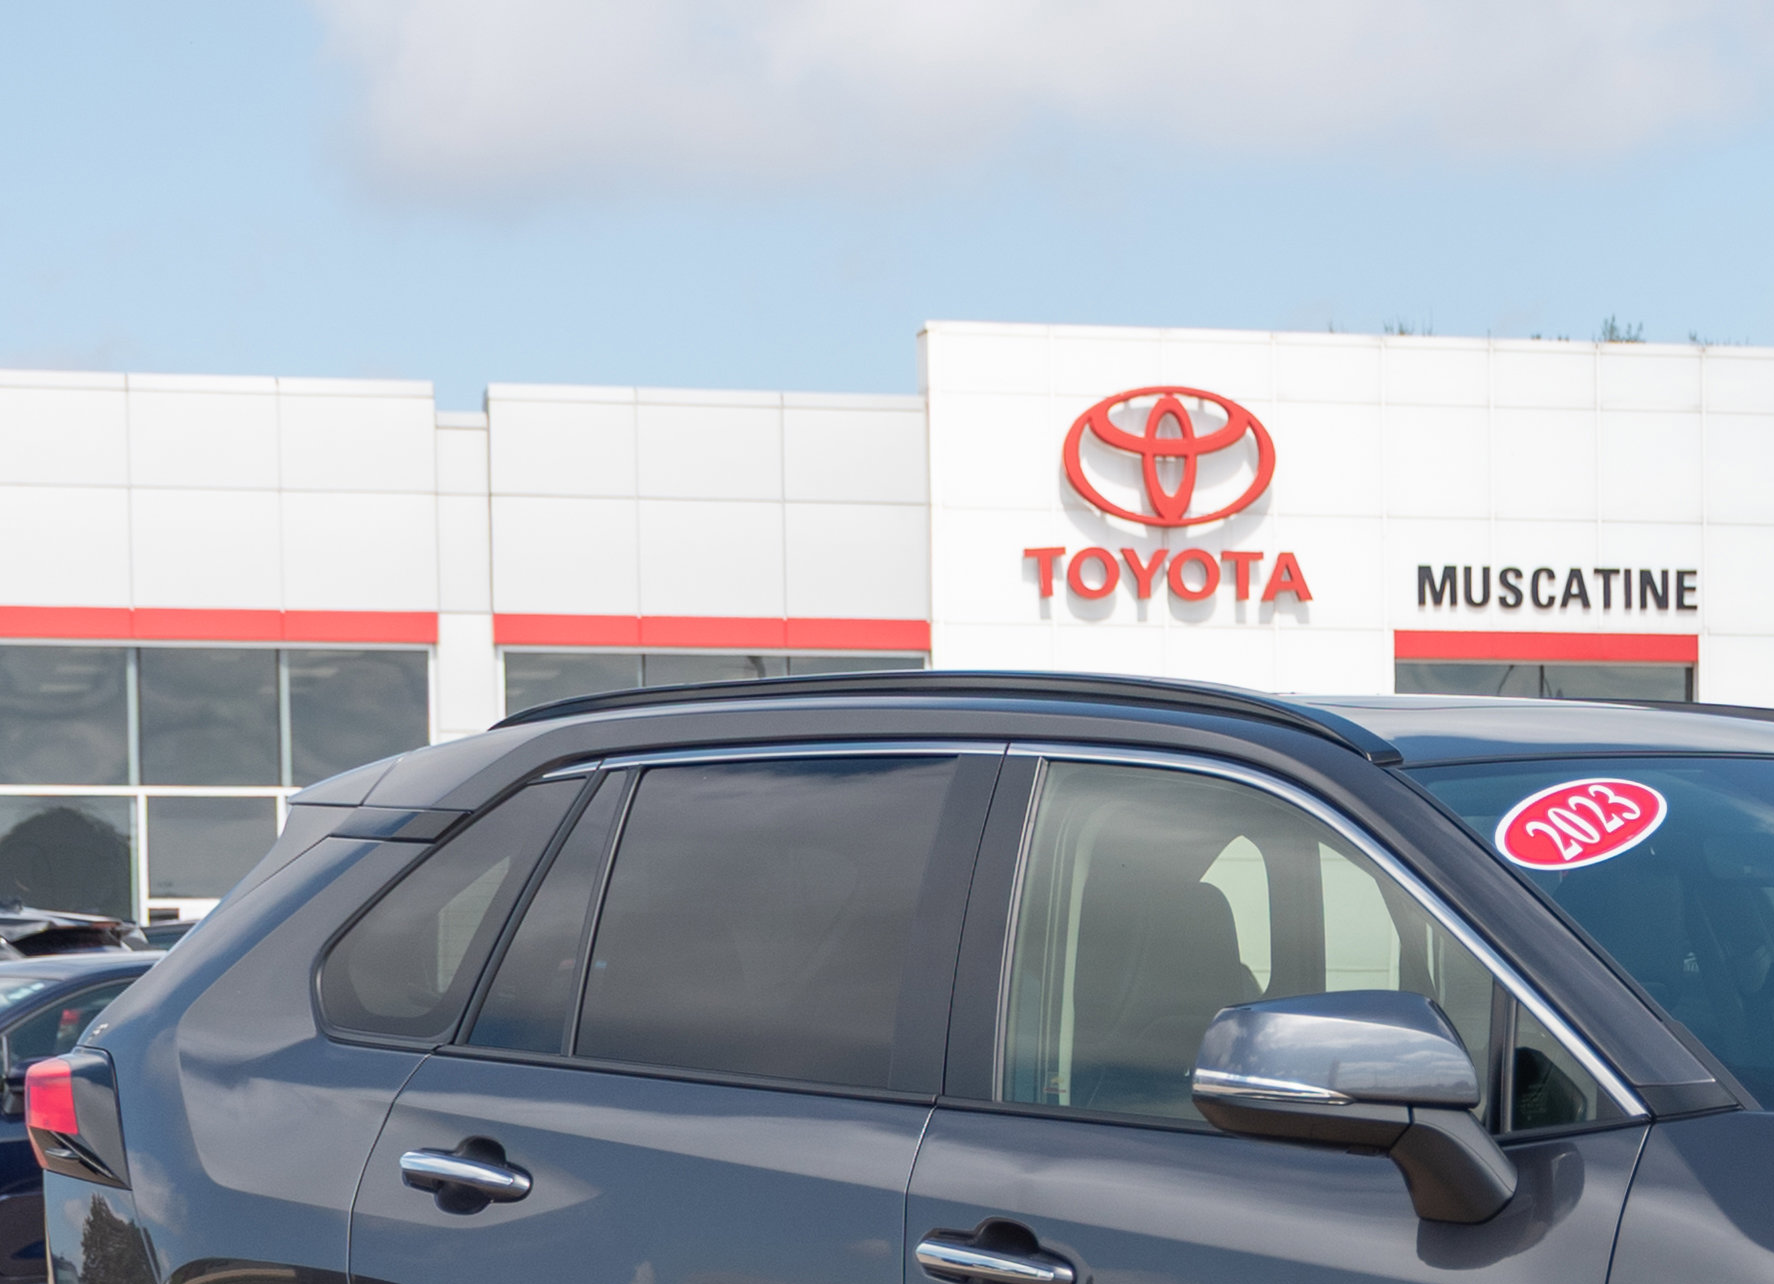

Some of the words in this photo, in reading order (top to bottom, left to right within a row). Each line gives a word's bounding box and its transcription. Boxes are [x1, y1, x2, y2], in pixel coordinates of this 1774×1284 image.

[1023, 546, 1314, 602] TOYOTA
[1417, 564, 1699, 612] MUSCATINE
[1525, 784, 1641, 862] 2023
